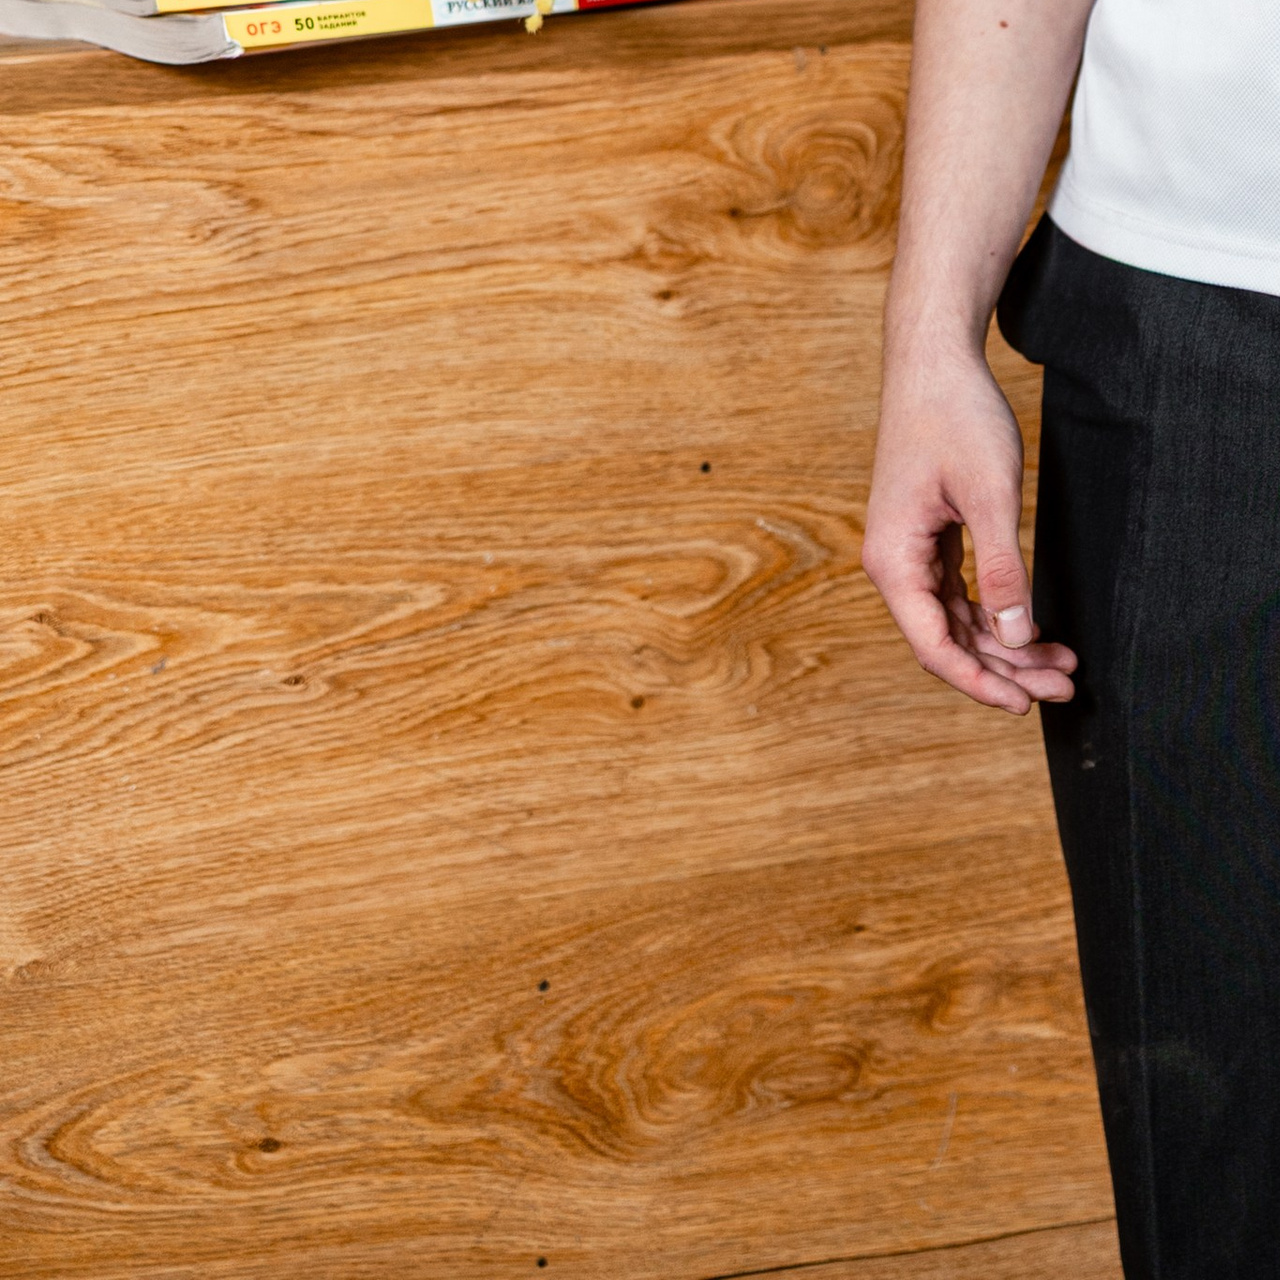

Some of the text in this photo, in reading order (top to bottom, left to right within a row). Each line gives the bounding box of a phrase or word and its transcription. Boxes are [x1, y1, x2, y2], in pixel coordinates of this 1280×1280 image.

[246, 11, 366, 36] ОГЭ 50 ВАРИАНТОВ
[319, 20, 358, 30] ЗАДАНИЙ
